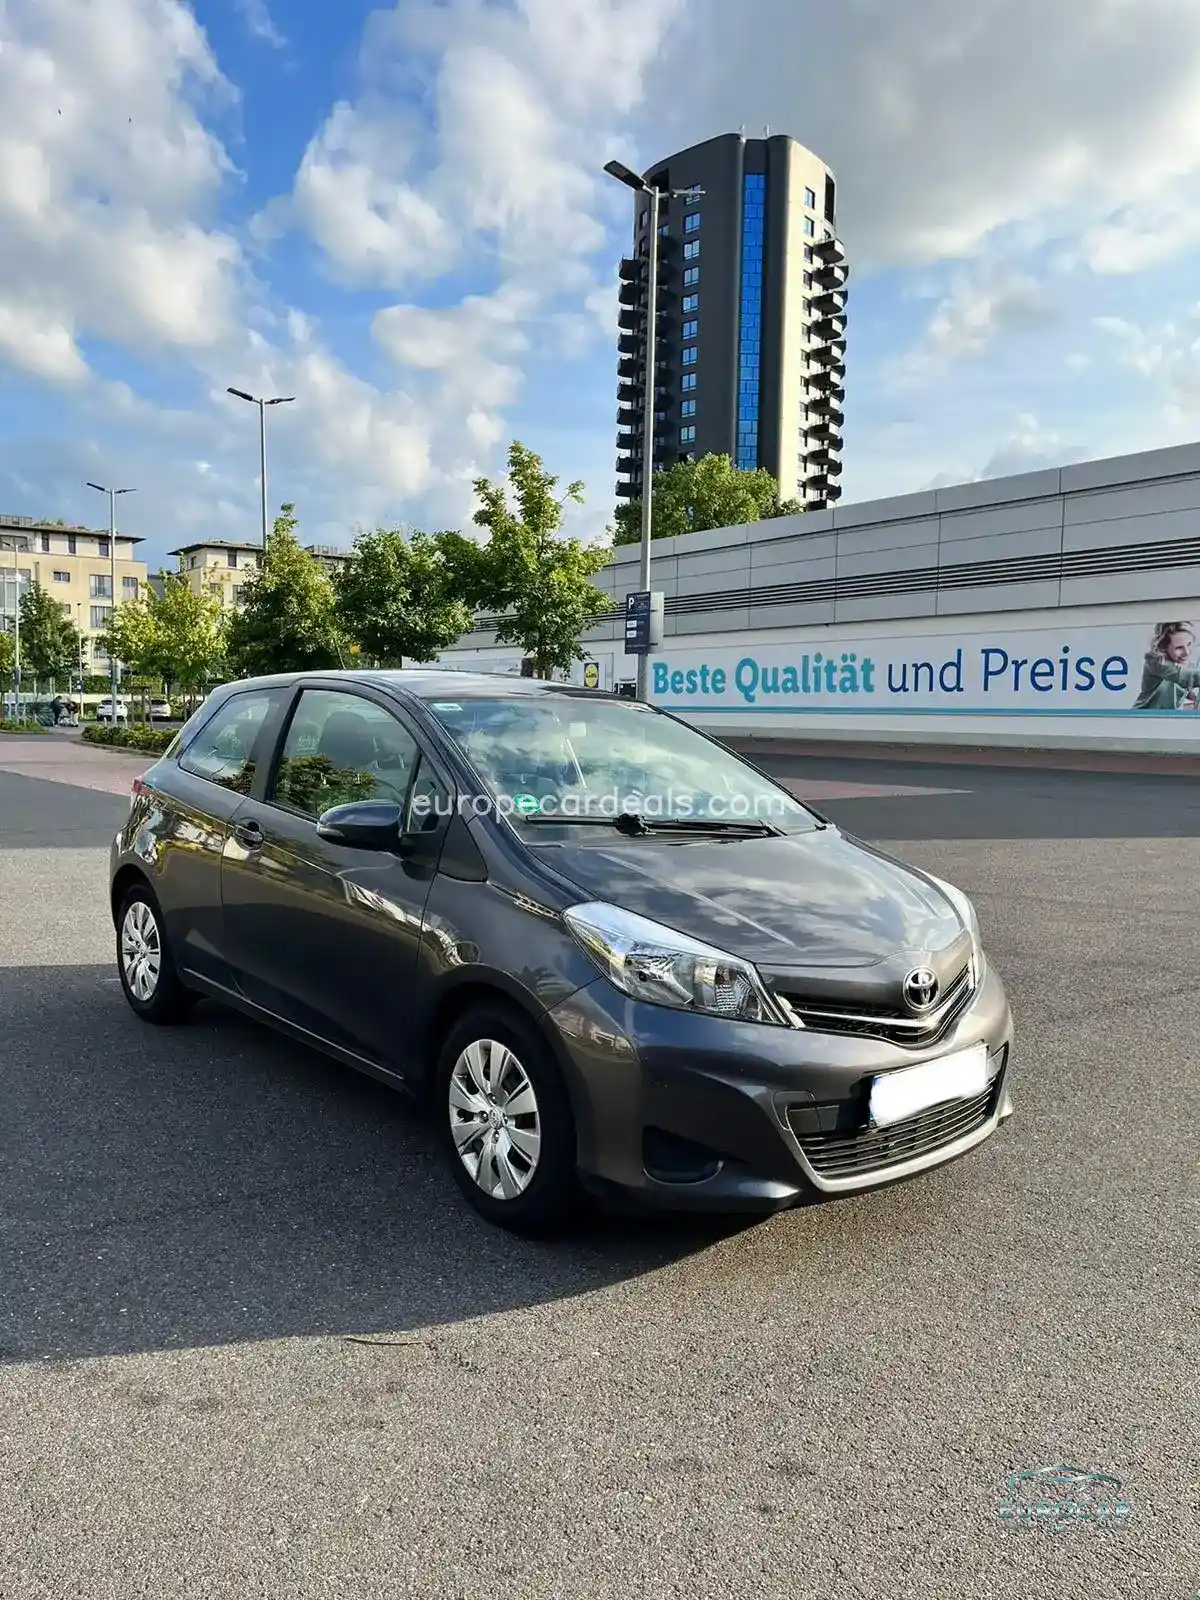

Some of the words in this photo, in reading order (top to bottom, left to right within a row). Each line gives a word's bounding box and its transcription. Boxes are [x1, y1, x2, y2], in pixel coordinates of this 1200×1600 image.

[628, 597, 635, 610] P
[652, 662, 727, 694] Beste
[735, 652, 875, 703] Qualität
[887, 648, 964, 693] und
[980, 645, 1129, 692] Preise
